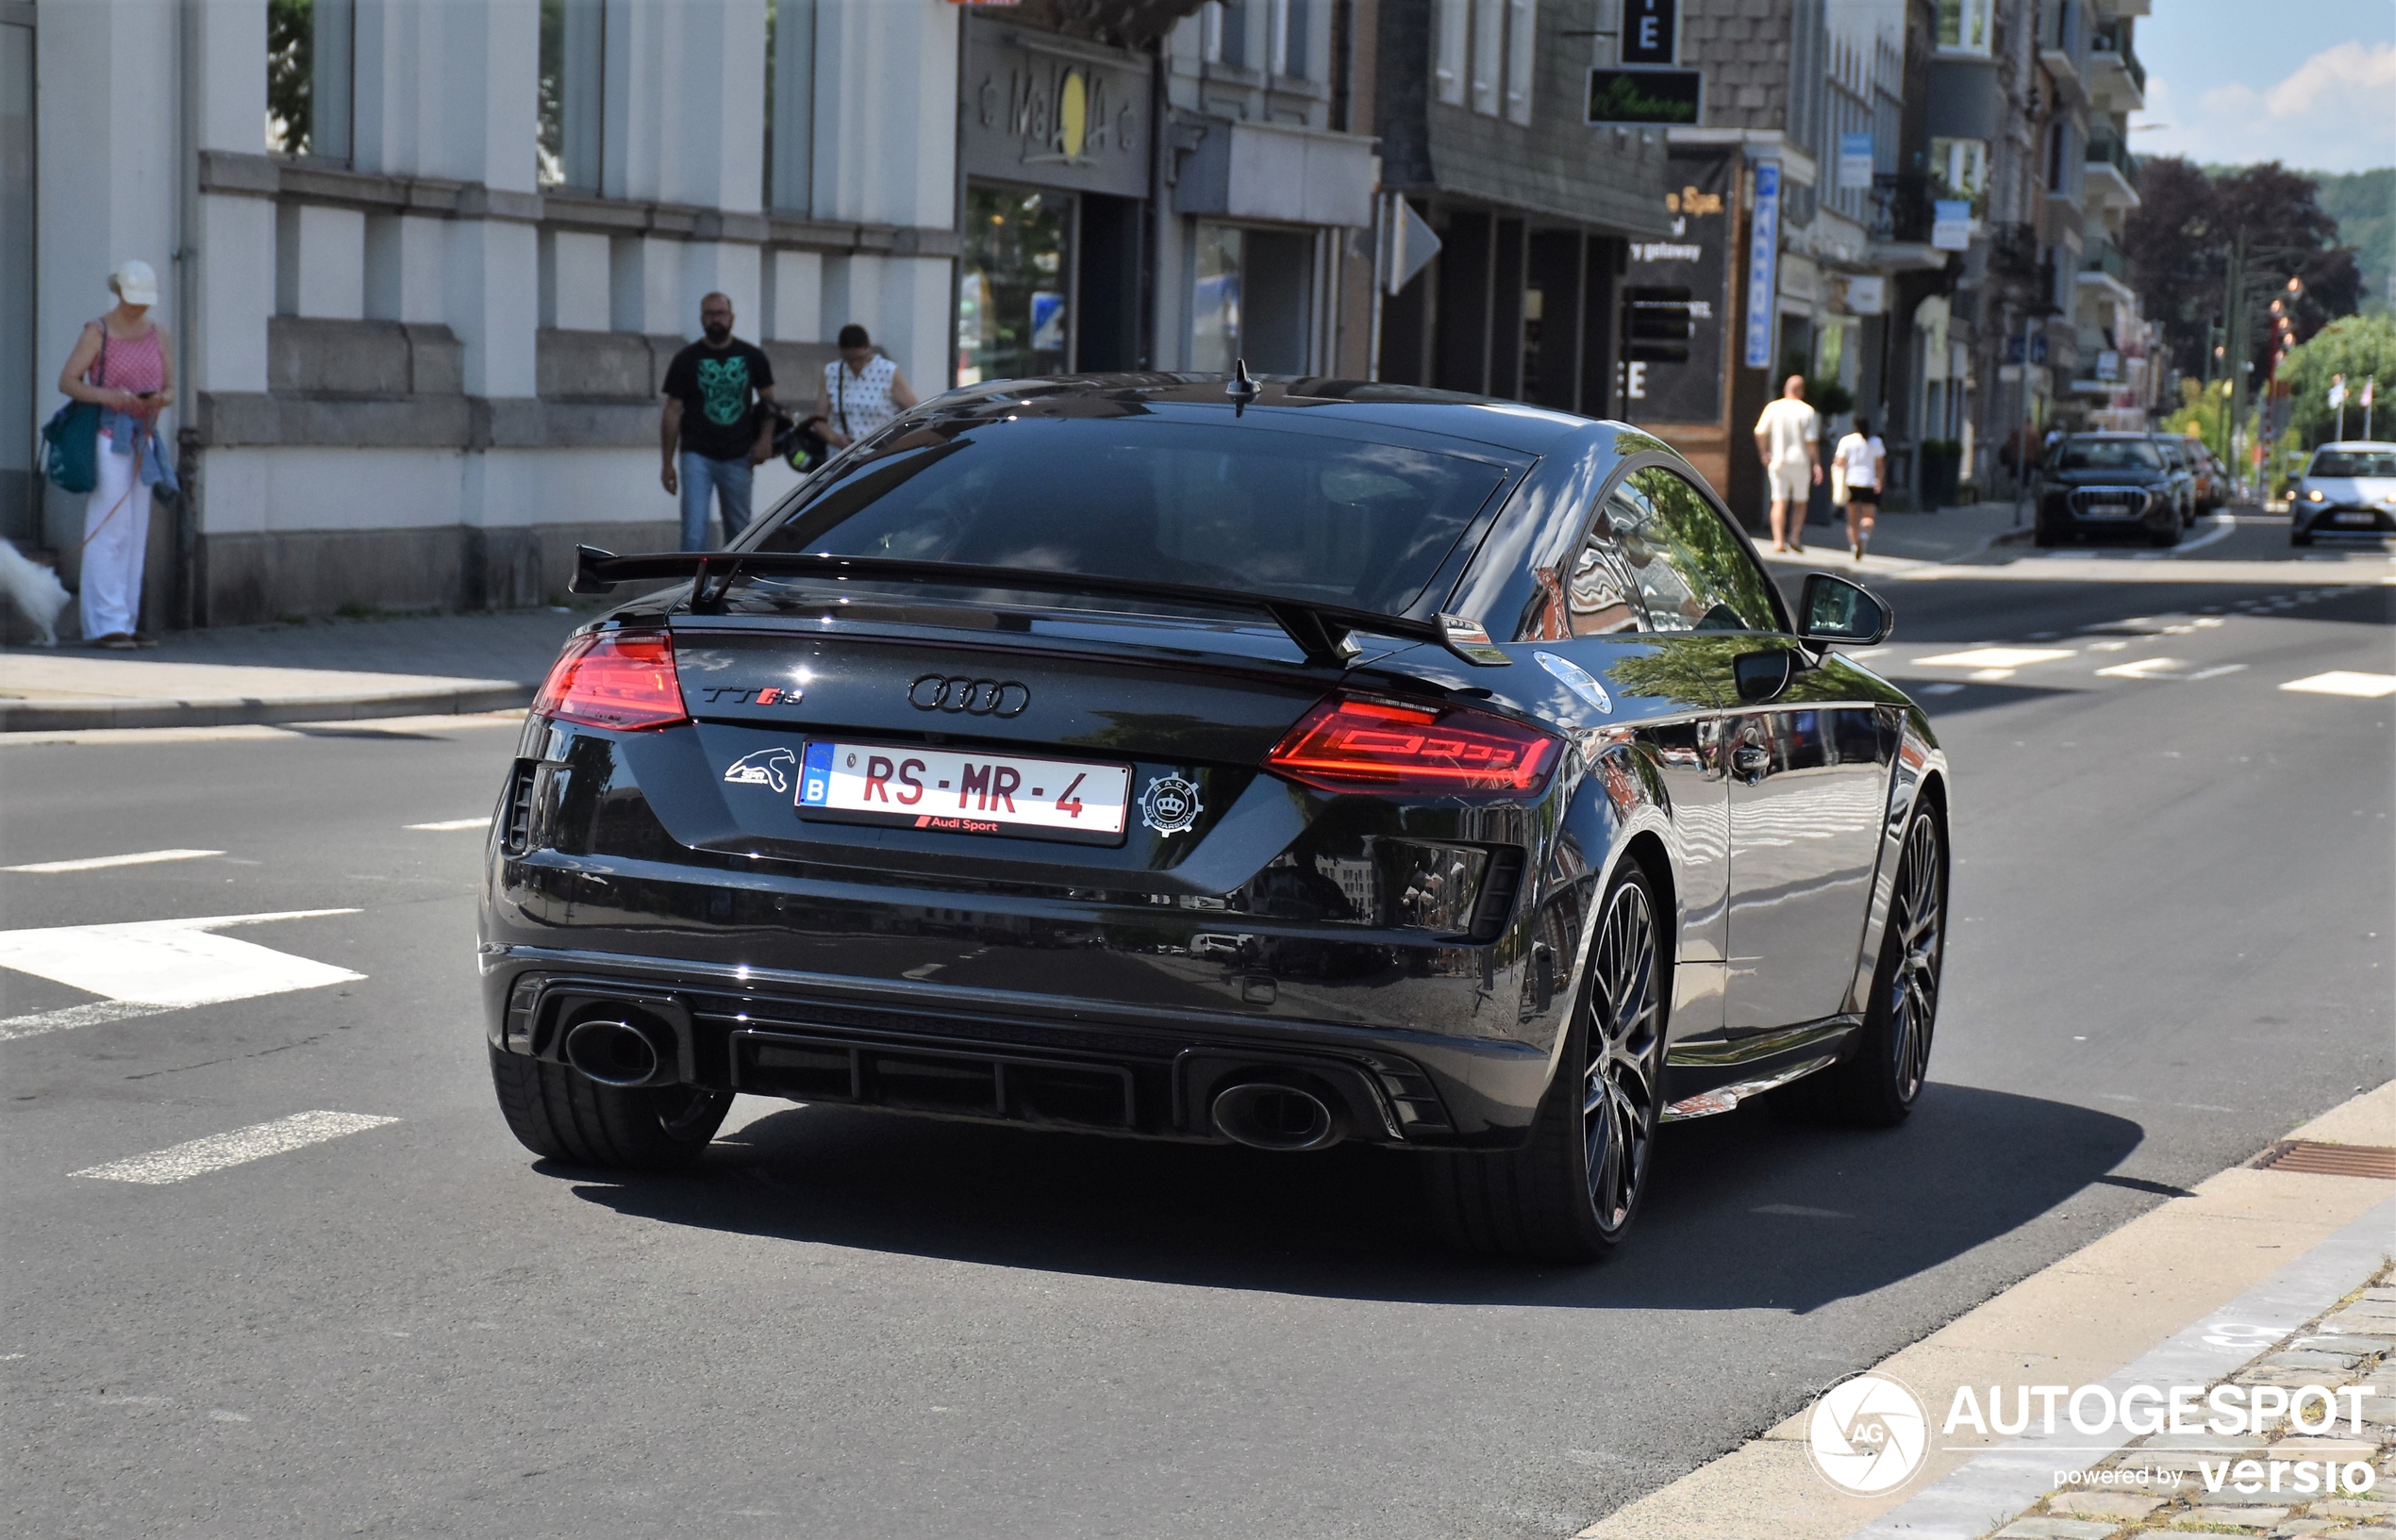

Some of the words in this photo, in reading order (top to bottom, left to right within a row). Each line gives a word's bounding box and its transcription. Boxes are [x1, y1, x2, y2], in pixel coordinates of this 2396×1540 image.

[807, 779, 824, 802] B
[1153, 780, 1192, 796] RACB
[931, 817, 960, 829] Audi
[962, 819, 998, 832] Sport
[1145, 805, 1156, 819] PIT
[1154, 810, 1194, 830] MARSHAL
